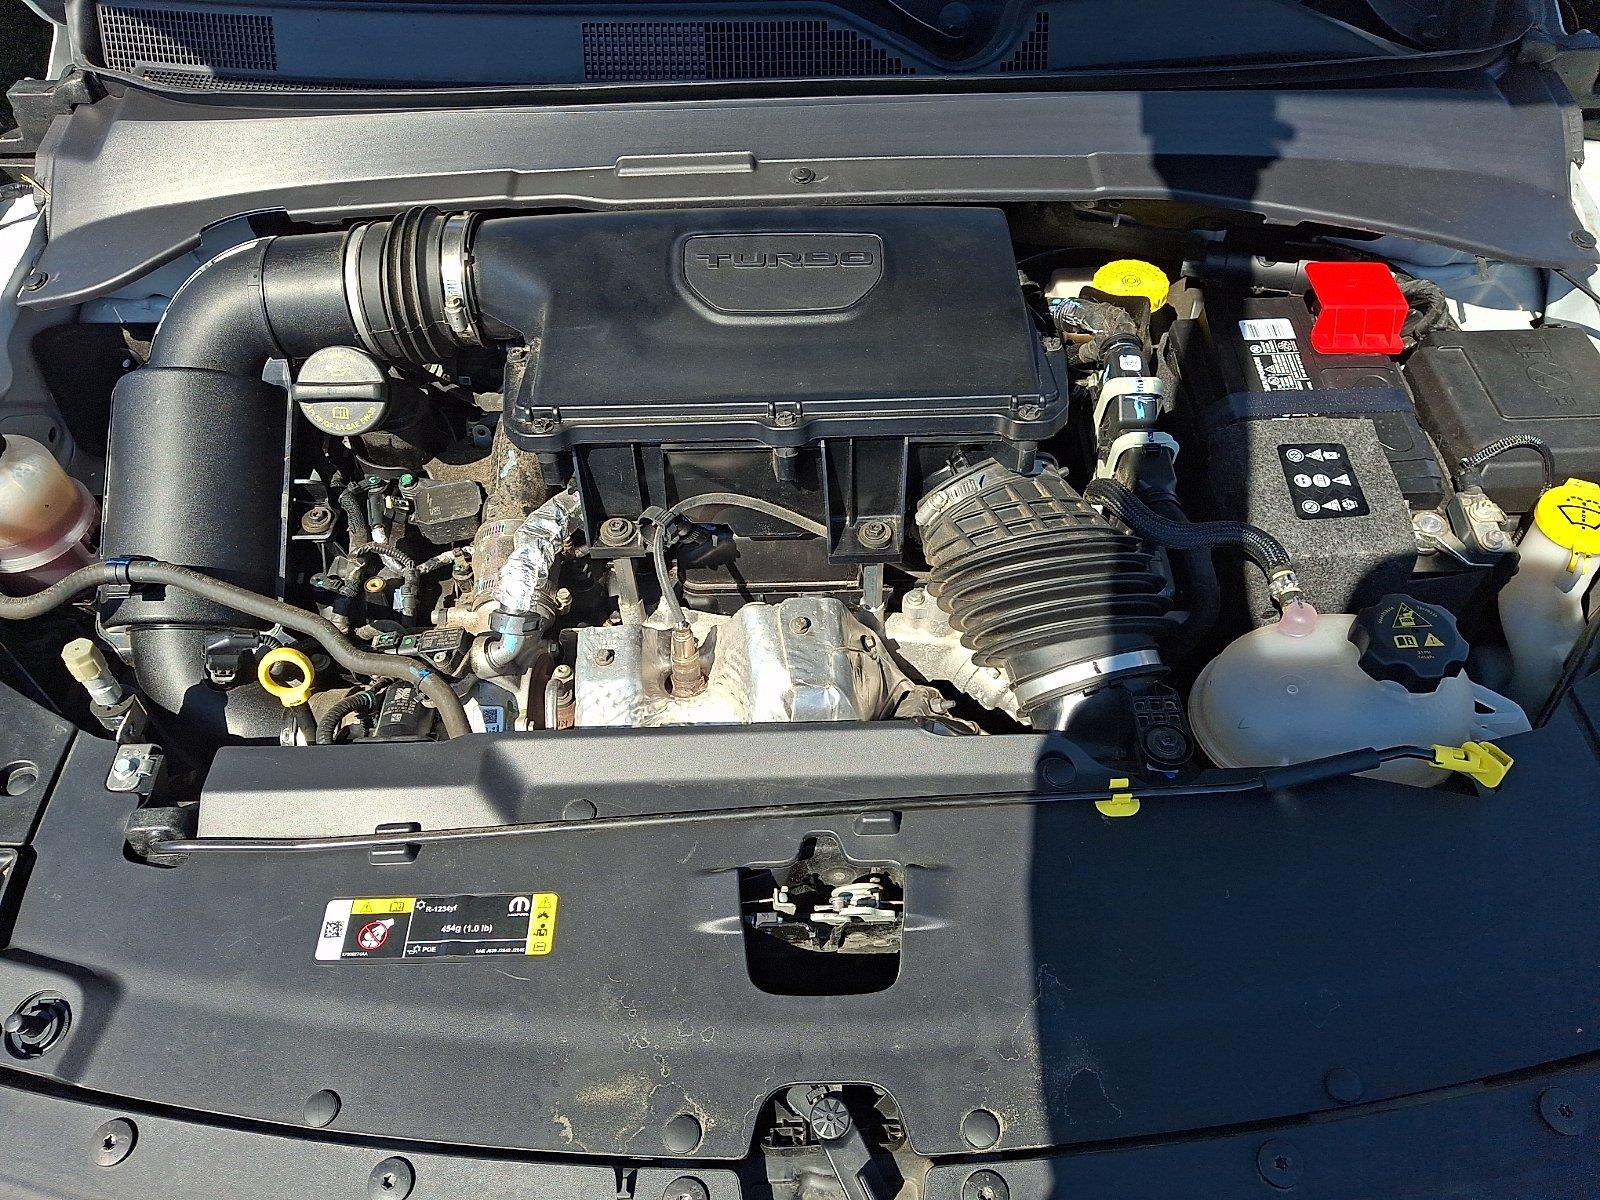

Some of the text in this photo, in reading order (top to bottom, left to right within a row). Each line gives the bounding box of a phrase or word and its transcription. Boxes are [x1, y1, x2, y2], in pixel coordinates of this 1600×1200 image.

[697, 251, 873, 269] TURBO
[425, 904, 458, 913] R-1234yf
[440, 924, 493, 934] 454g (1.0 lb)
